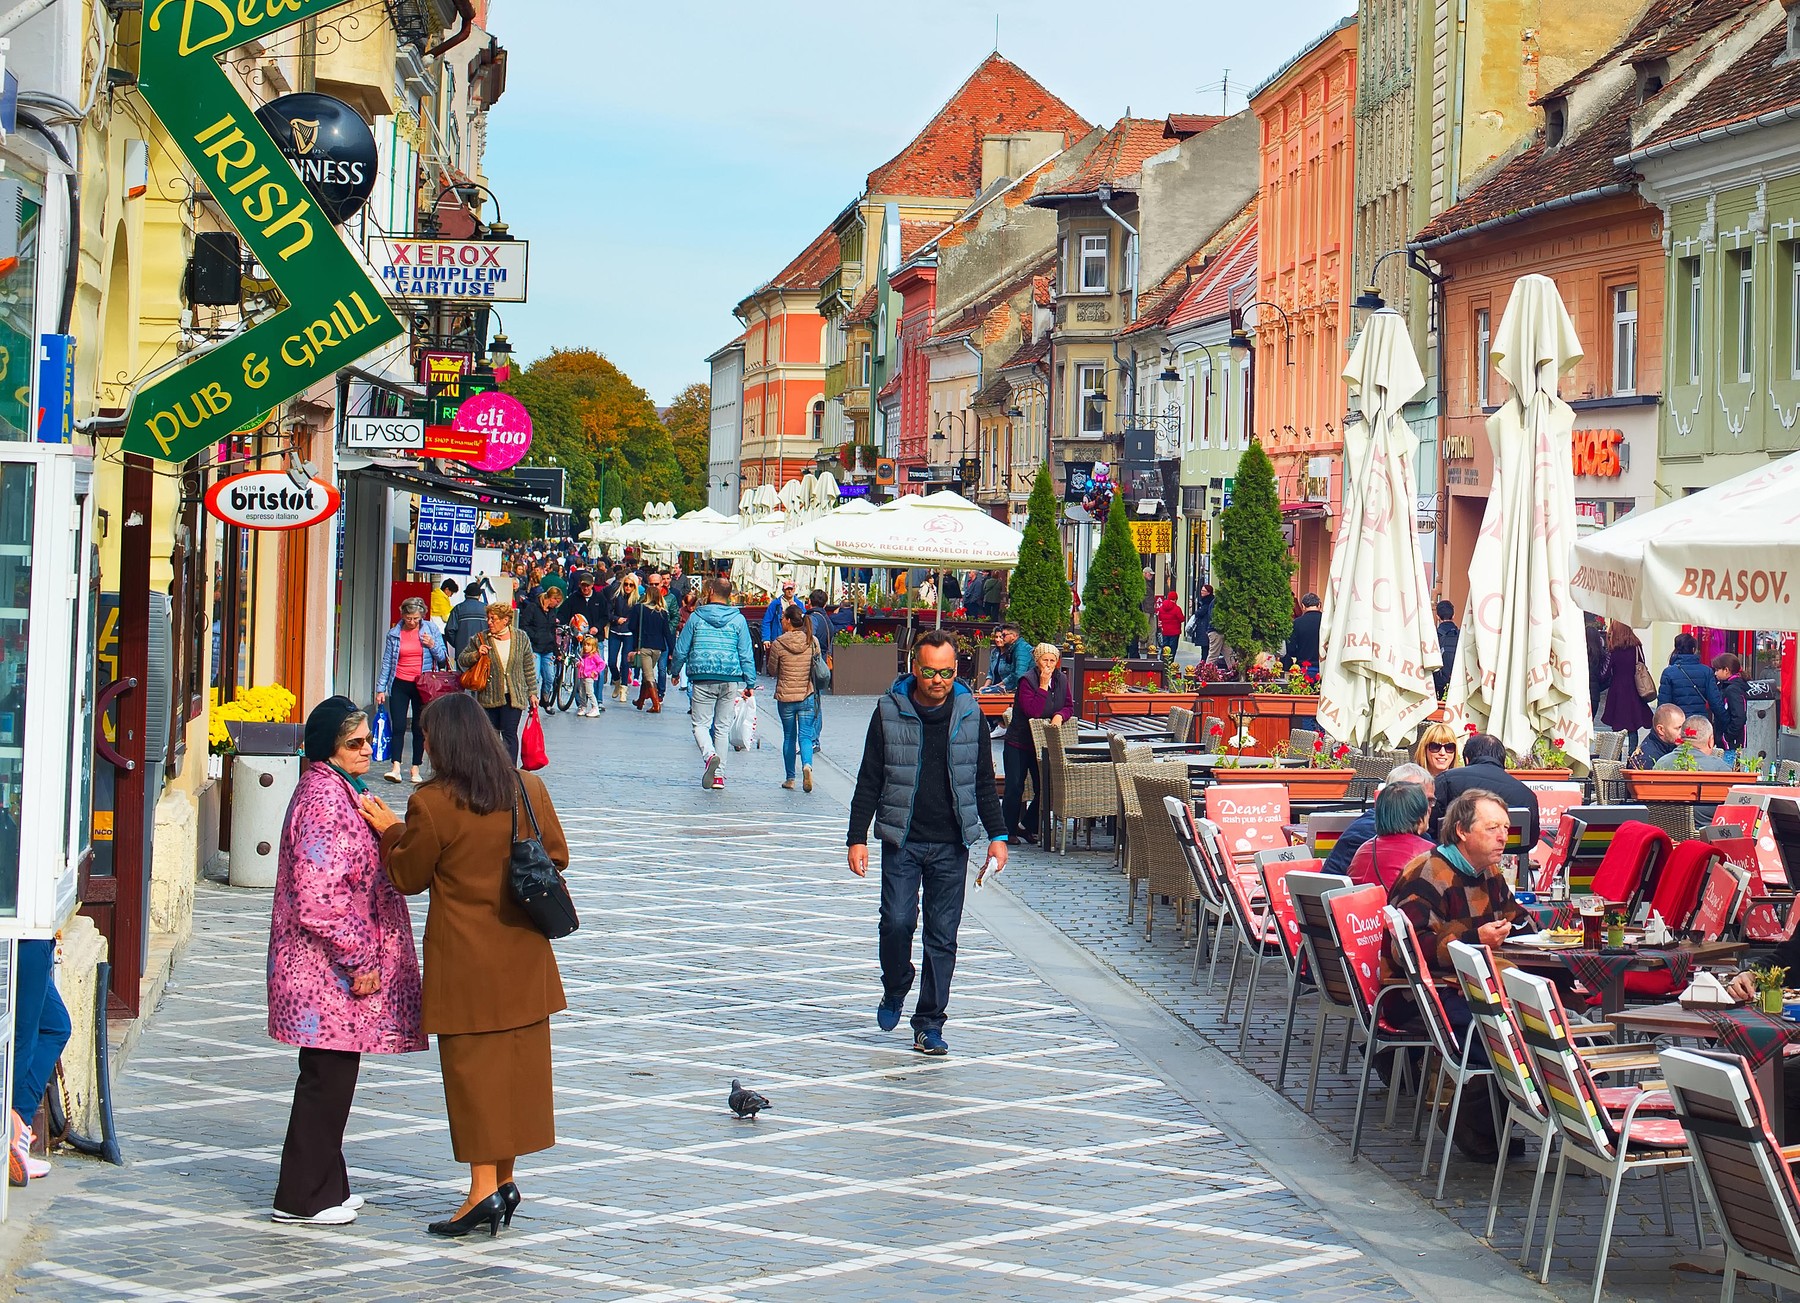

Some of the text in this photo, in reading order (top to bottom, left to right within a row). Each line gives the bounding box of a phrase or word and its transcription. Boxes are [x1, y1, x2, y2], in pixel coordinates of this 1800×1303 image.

[288, 158, 364, 185] NNESS
[392, 243, 501, 268] XEROX
[383, 265, 508, 282] REUMPLEM
[395, 280, 496, 296] CARTUSE
[241, 352, 270, 389] &
[476, 407, 504, 427] eli
[351, 424, 421, 442] IL PASSO
[1571, 428, 1623, 477] HOES
[231, 485, 315, 510] bristot
[245, 512, 299, 521] espresso italiano
[419, 522, 432, 531] EUR
[432, 522, 449, 532] 4.45
[418, 540, 470, 552] USD 3.95 4.05
[880, 543, 914, 551] REGELE
[417, 553, 471, 564] COMISION 0%
